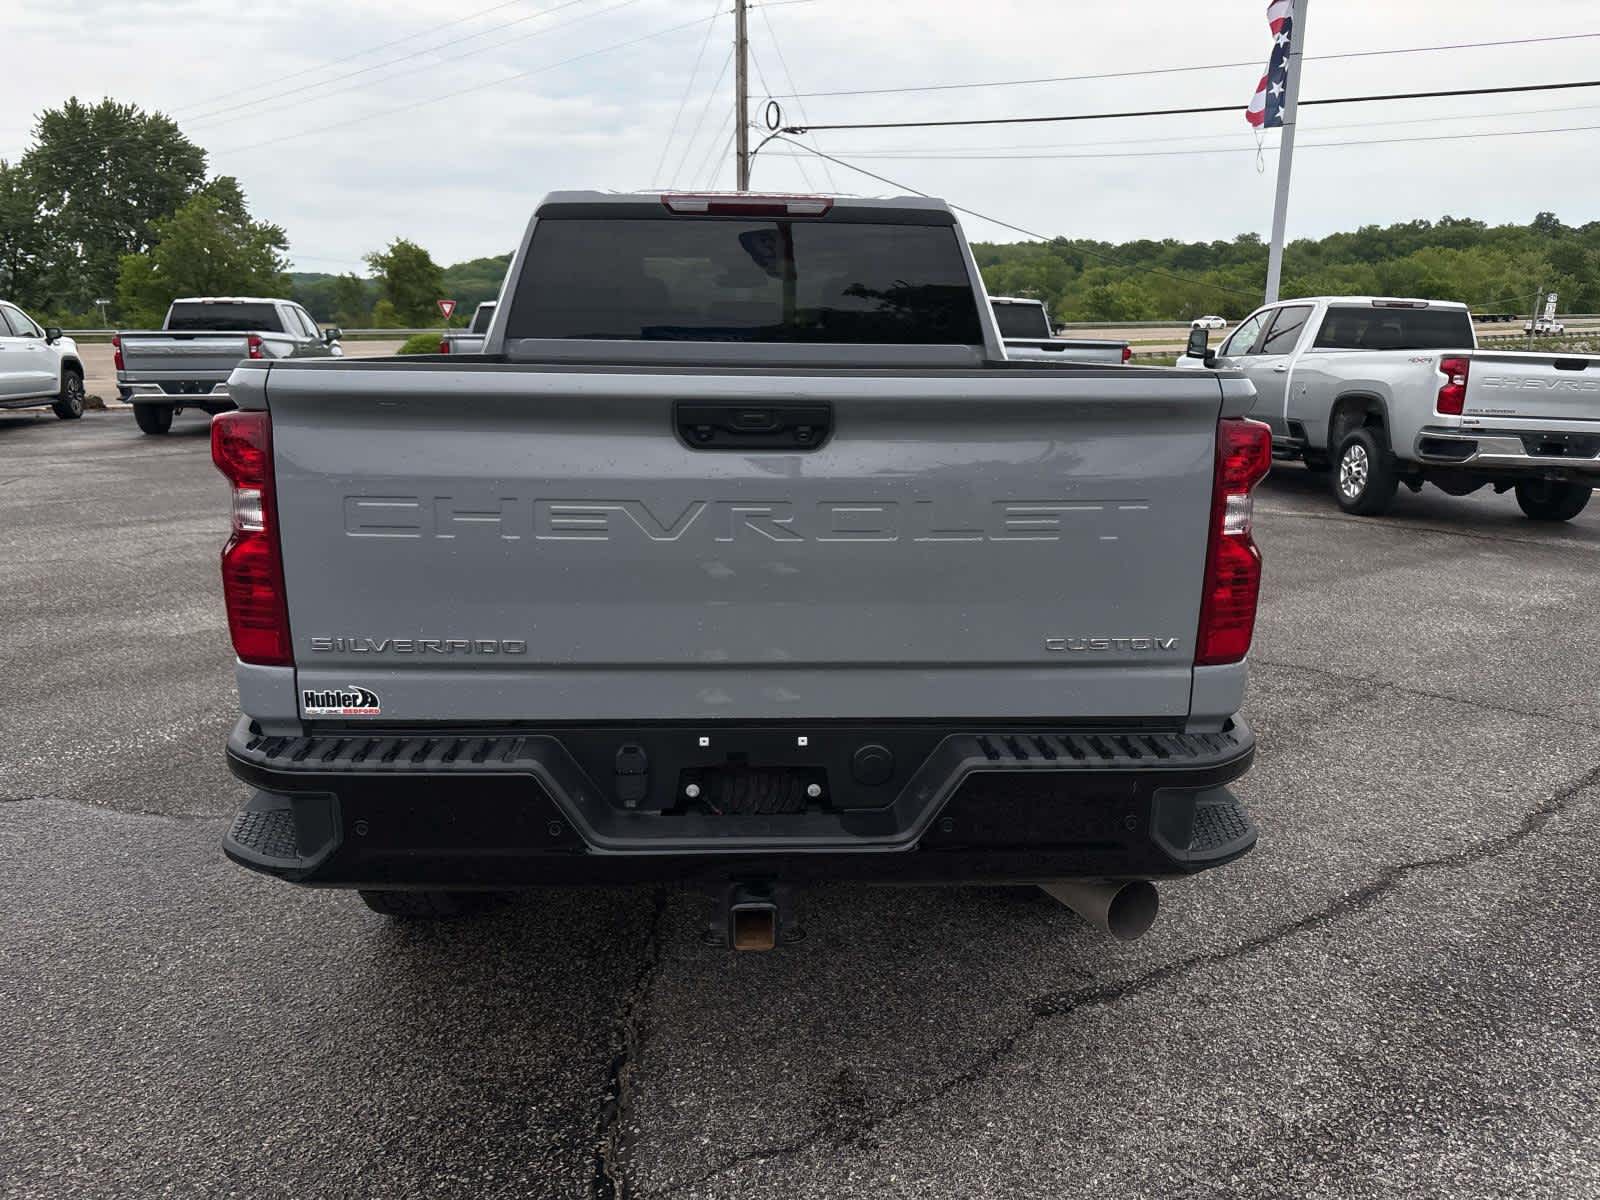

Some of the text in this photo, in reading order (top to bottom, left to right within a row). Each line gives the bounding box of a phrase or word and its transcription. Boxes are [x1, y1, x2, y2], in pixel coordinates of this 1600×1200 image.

[344, 495, 1149, 541] CHEVROLET
[311, 637, 528, 654] SILVERADO
[1046, 637, 1180, 651] CUSTOM
[303, 691, 360, 708] Hubler
